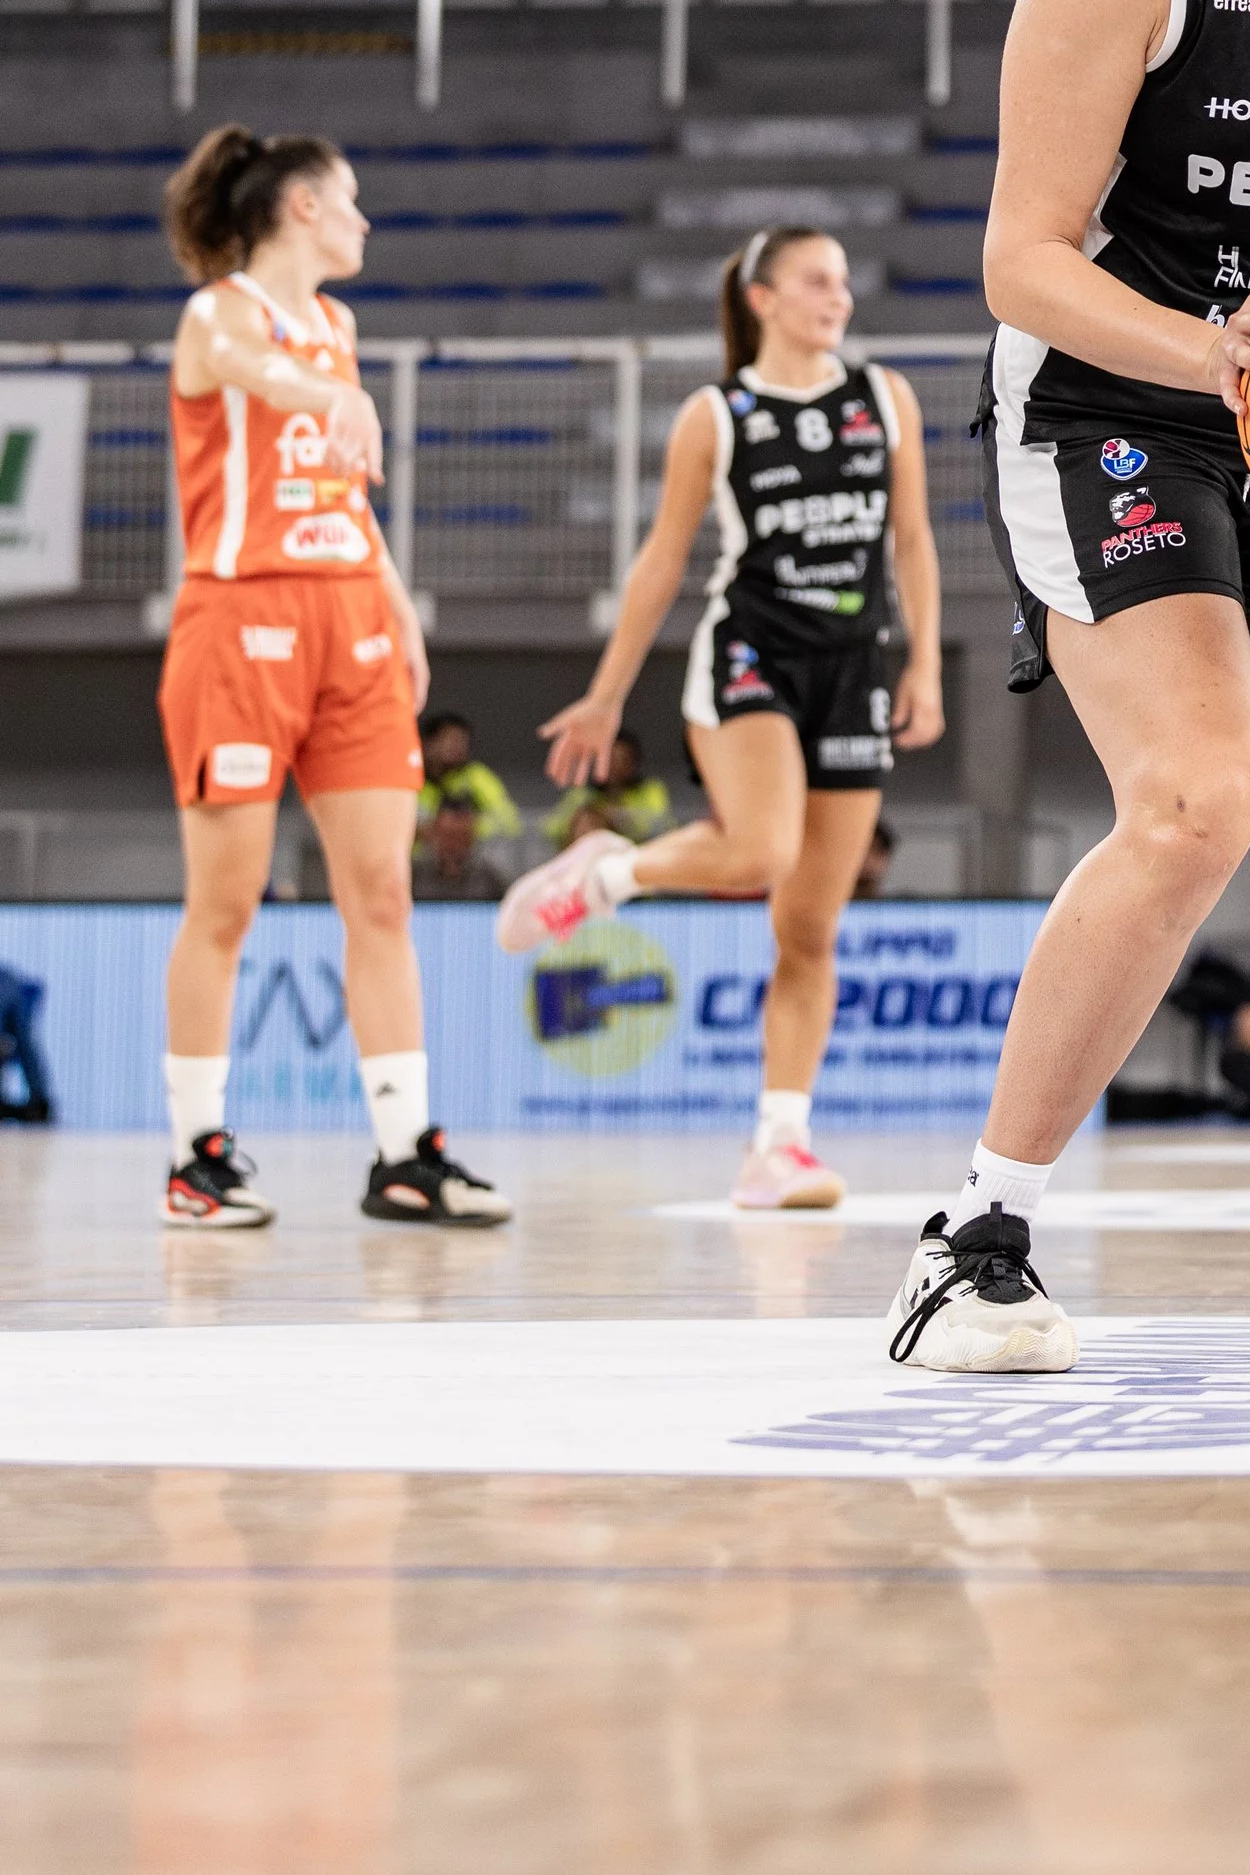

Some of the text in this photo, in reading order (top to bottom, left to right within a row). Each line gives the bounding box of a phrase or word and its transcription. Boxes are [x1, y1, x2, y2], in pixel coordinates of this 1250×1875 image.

[794, 407, 834, 453] 8
[1113, 457, 1136, 470] LBF
[1101, 522, 1183, 552] PANTHERS
[1103, 532, 1187, 568] ROSETO
